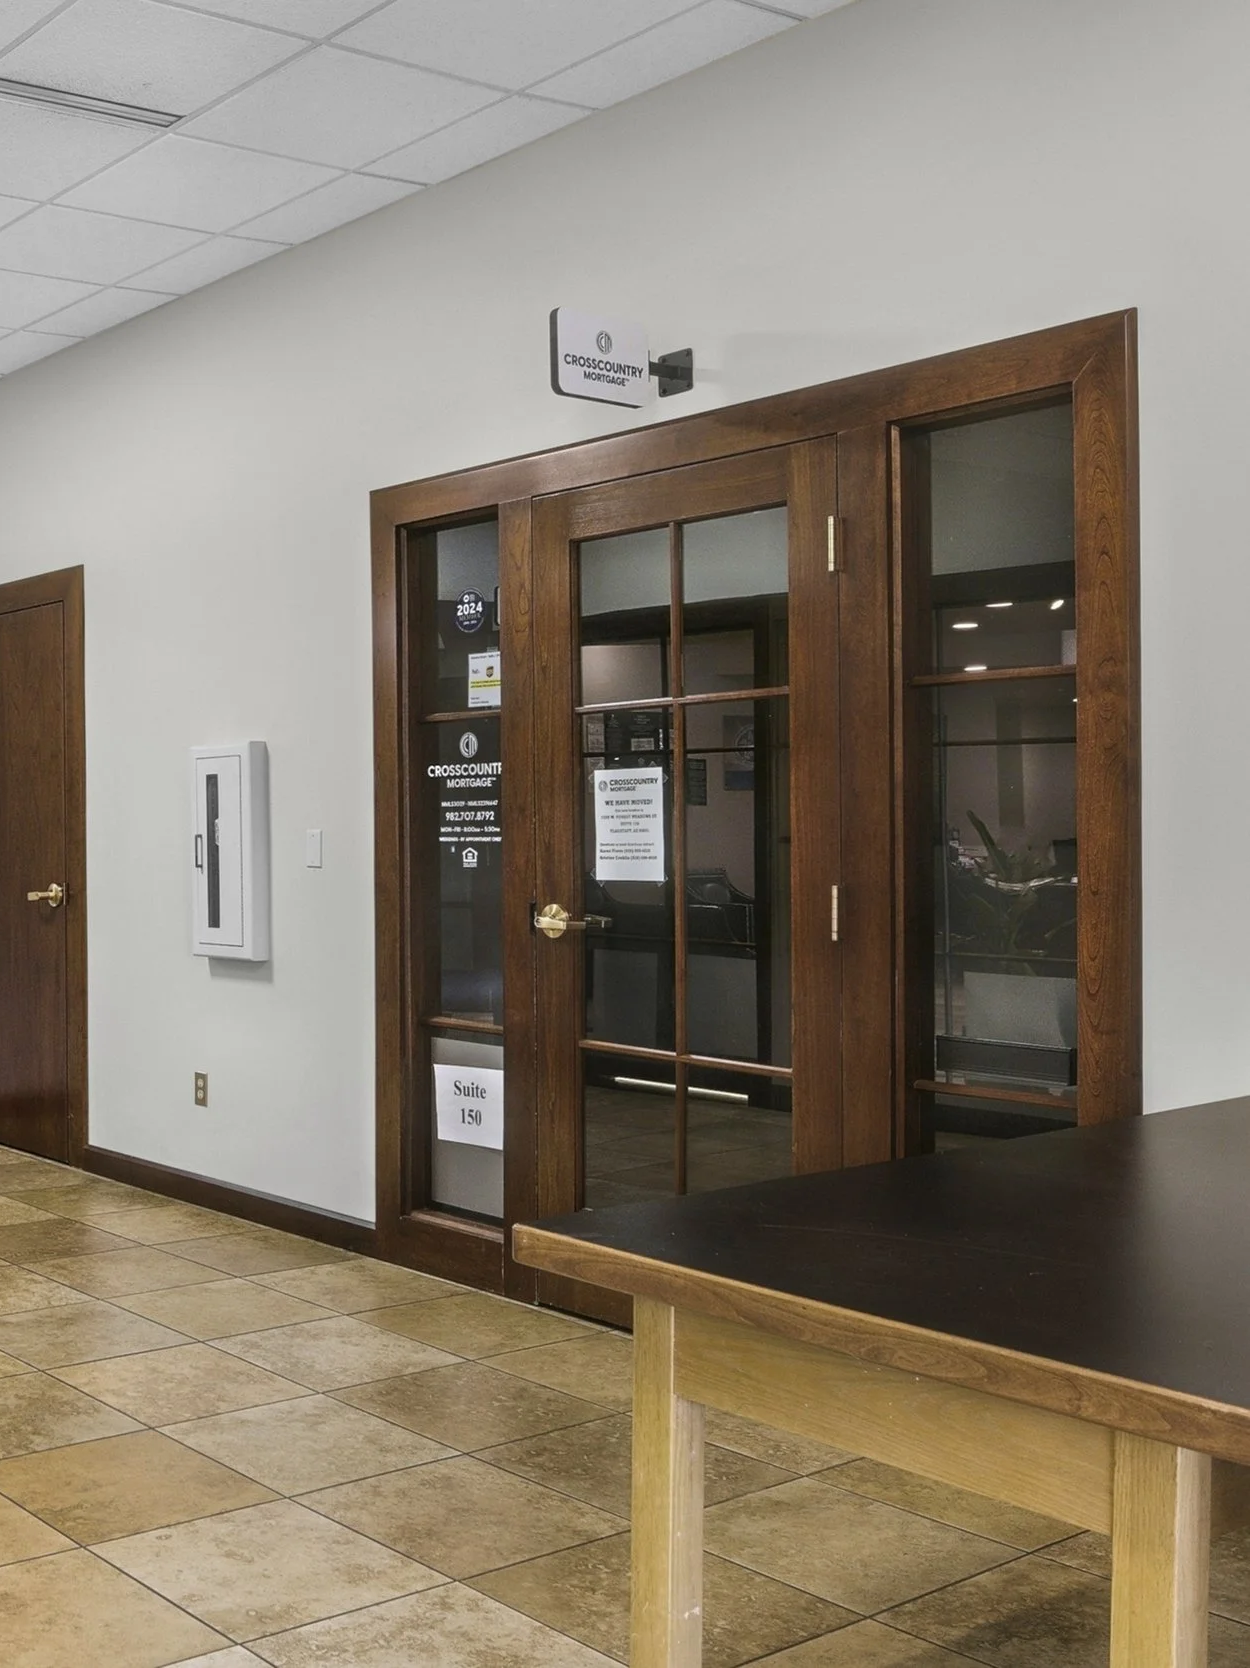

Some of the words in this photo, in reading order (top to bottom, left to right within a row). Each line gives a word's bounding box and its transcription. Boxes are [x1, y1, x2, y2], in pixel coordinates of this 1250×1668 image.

[563, 353, 644, 379] CROSSCOUNTRY
[456, 601, 483, 616] 2024
[427, 761, 502, 777] CROSSCOUNTR
[609, 777, 659, 786] CROSSCOUNTRY
[453, 1080, 487, 1100] Suite
[460, 1108, 482, 1127] 150
